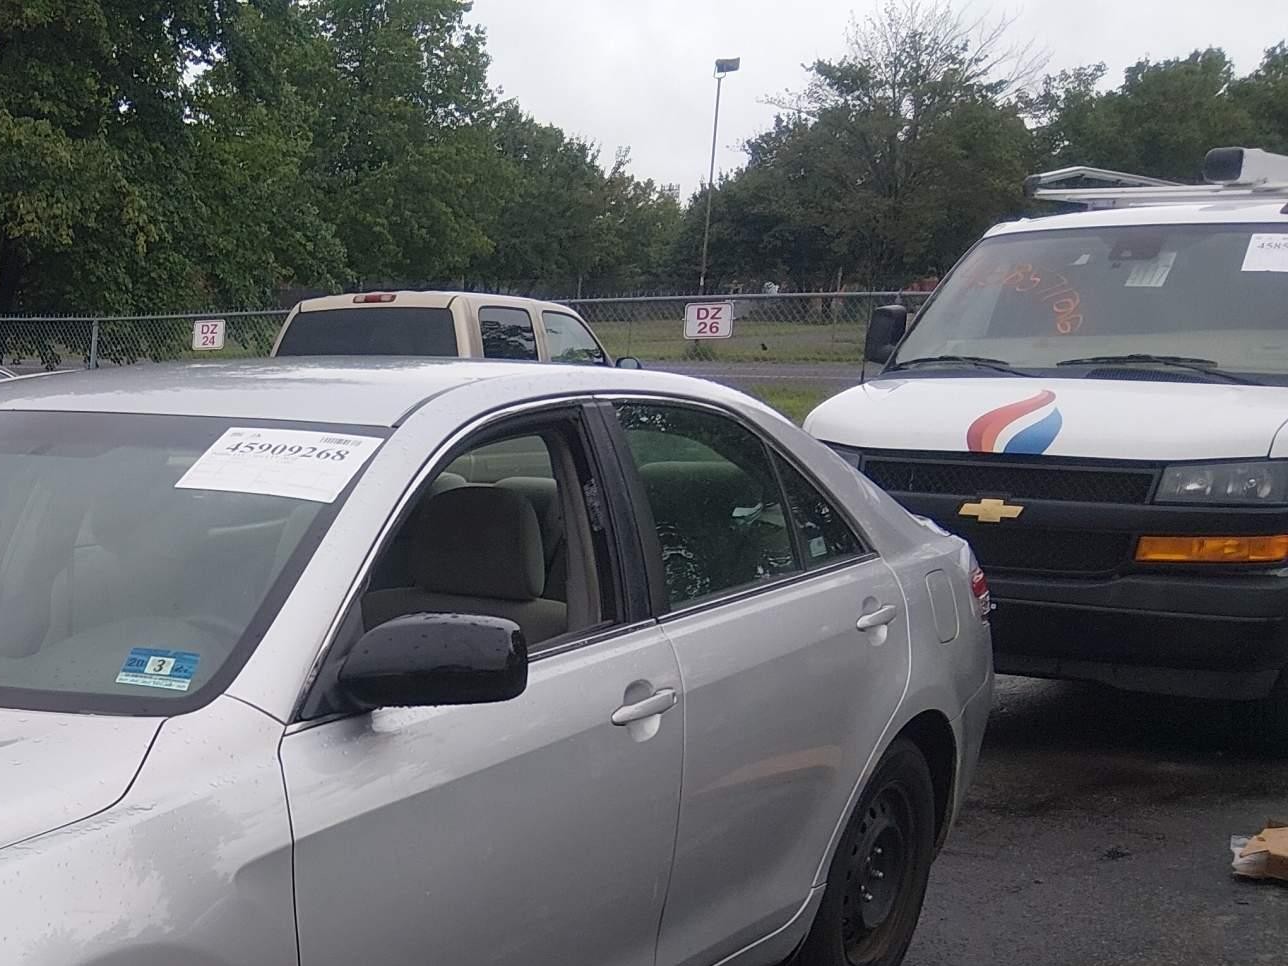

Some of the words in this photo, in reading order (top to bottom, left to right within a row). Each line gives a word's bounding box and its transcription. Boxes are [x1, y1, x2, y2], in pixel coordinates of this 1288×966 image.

[696, 307, 722, 320] DZ
[201, 324, 218, 335] DZ
[697, 321, 720, 334] 26
[202, 335, 216, 346] 24
[226, 441, 350, 461] 45909268
[153, 659, 166, 673] 3
